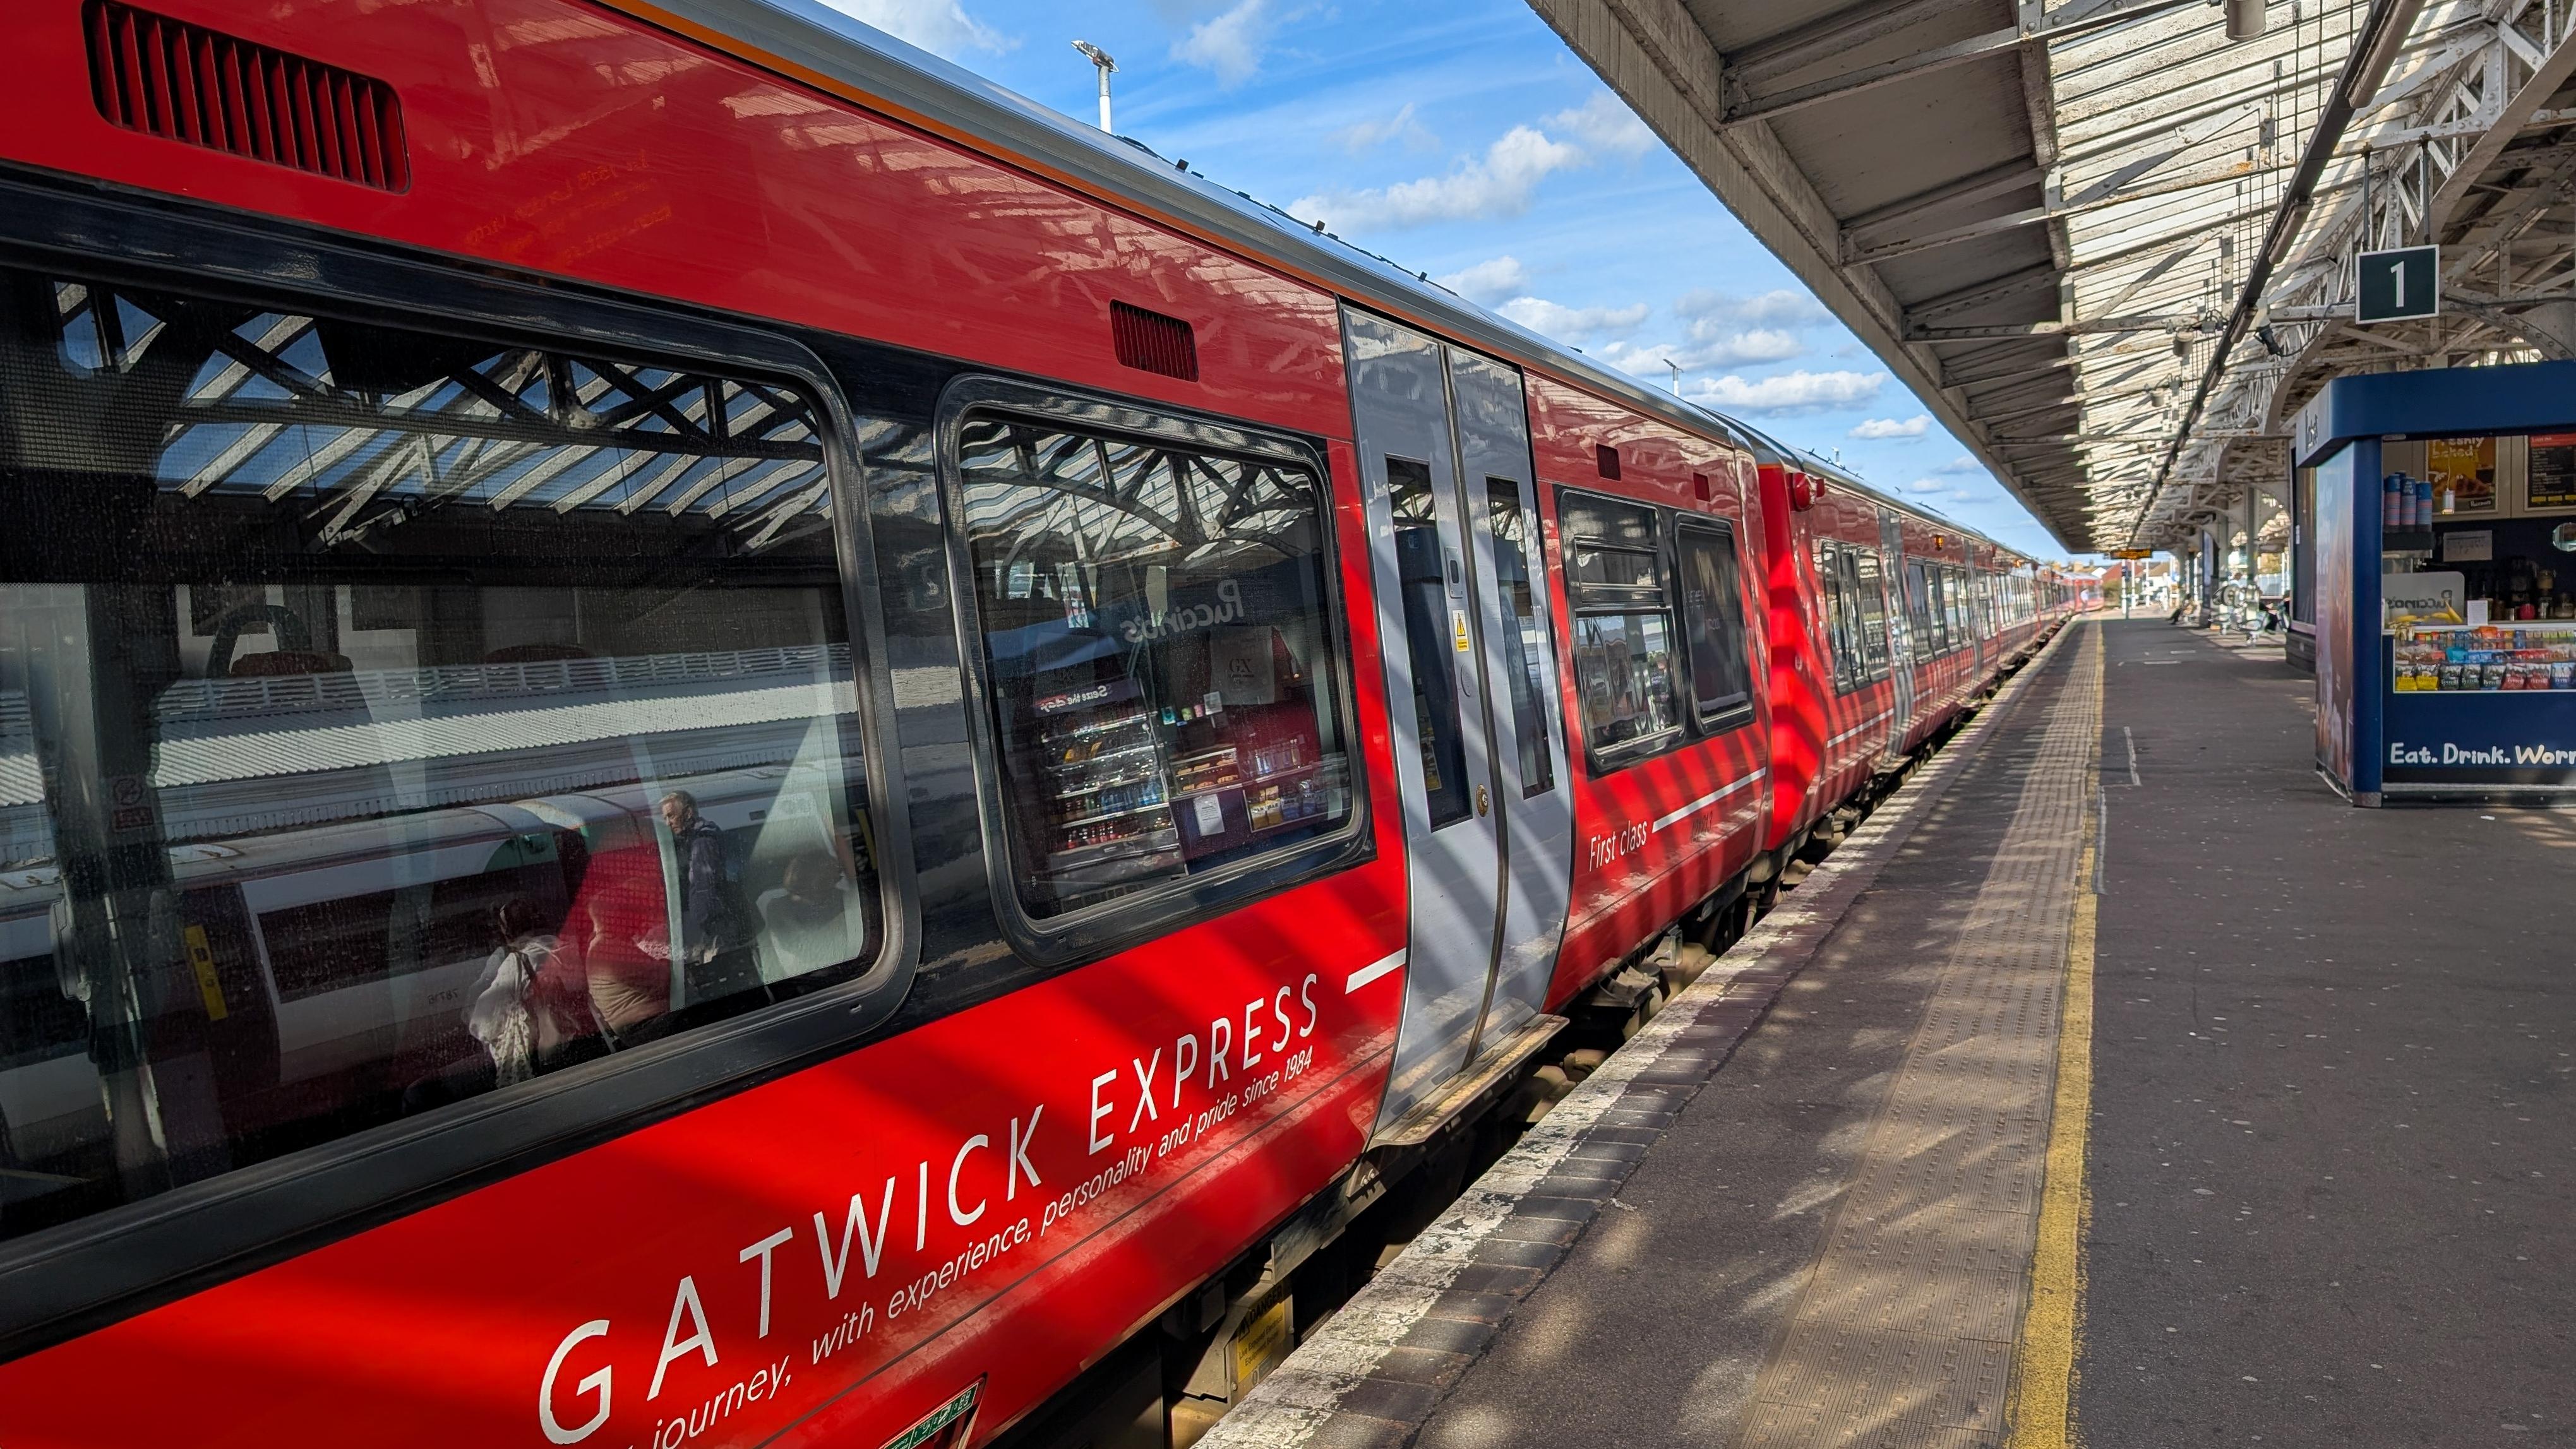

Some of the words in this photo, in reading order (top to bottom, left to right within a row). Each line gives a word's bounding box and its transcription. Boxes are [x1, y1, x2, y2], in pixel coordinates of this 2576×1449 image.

[2390, 260, 2405, 308] 1
[2390, 742, 2438, 765] Eat.
[2443, 742, 2510, 765] Drink.
[1589, 831, 1617, 872] First
[1620, 820, 1648, 856] class
[539, 1103, 1044, 1445] GATWICK
[1089, 973, 1317, 1156] EXPRESS
[812, 1301, 874, 1366] with
[888, 1217, 1033, 1319] experience,
[1040, 1142, 1153, 1237] personality
[1158, 1113, 1192, 1157] and
[1194, 1092, 1237, 1142] pride
[1242, 1070, 1279, 1107] since
[1283, 1045, 1313, 1083] 1984
[1250, 1284, 1283, 1325] DANGER
